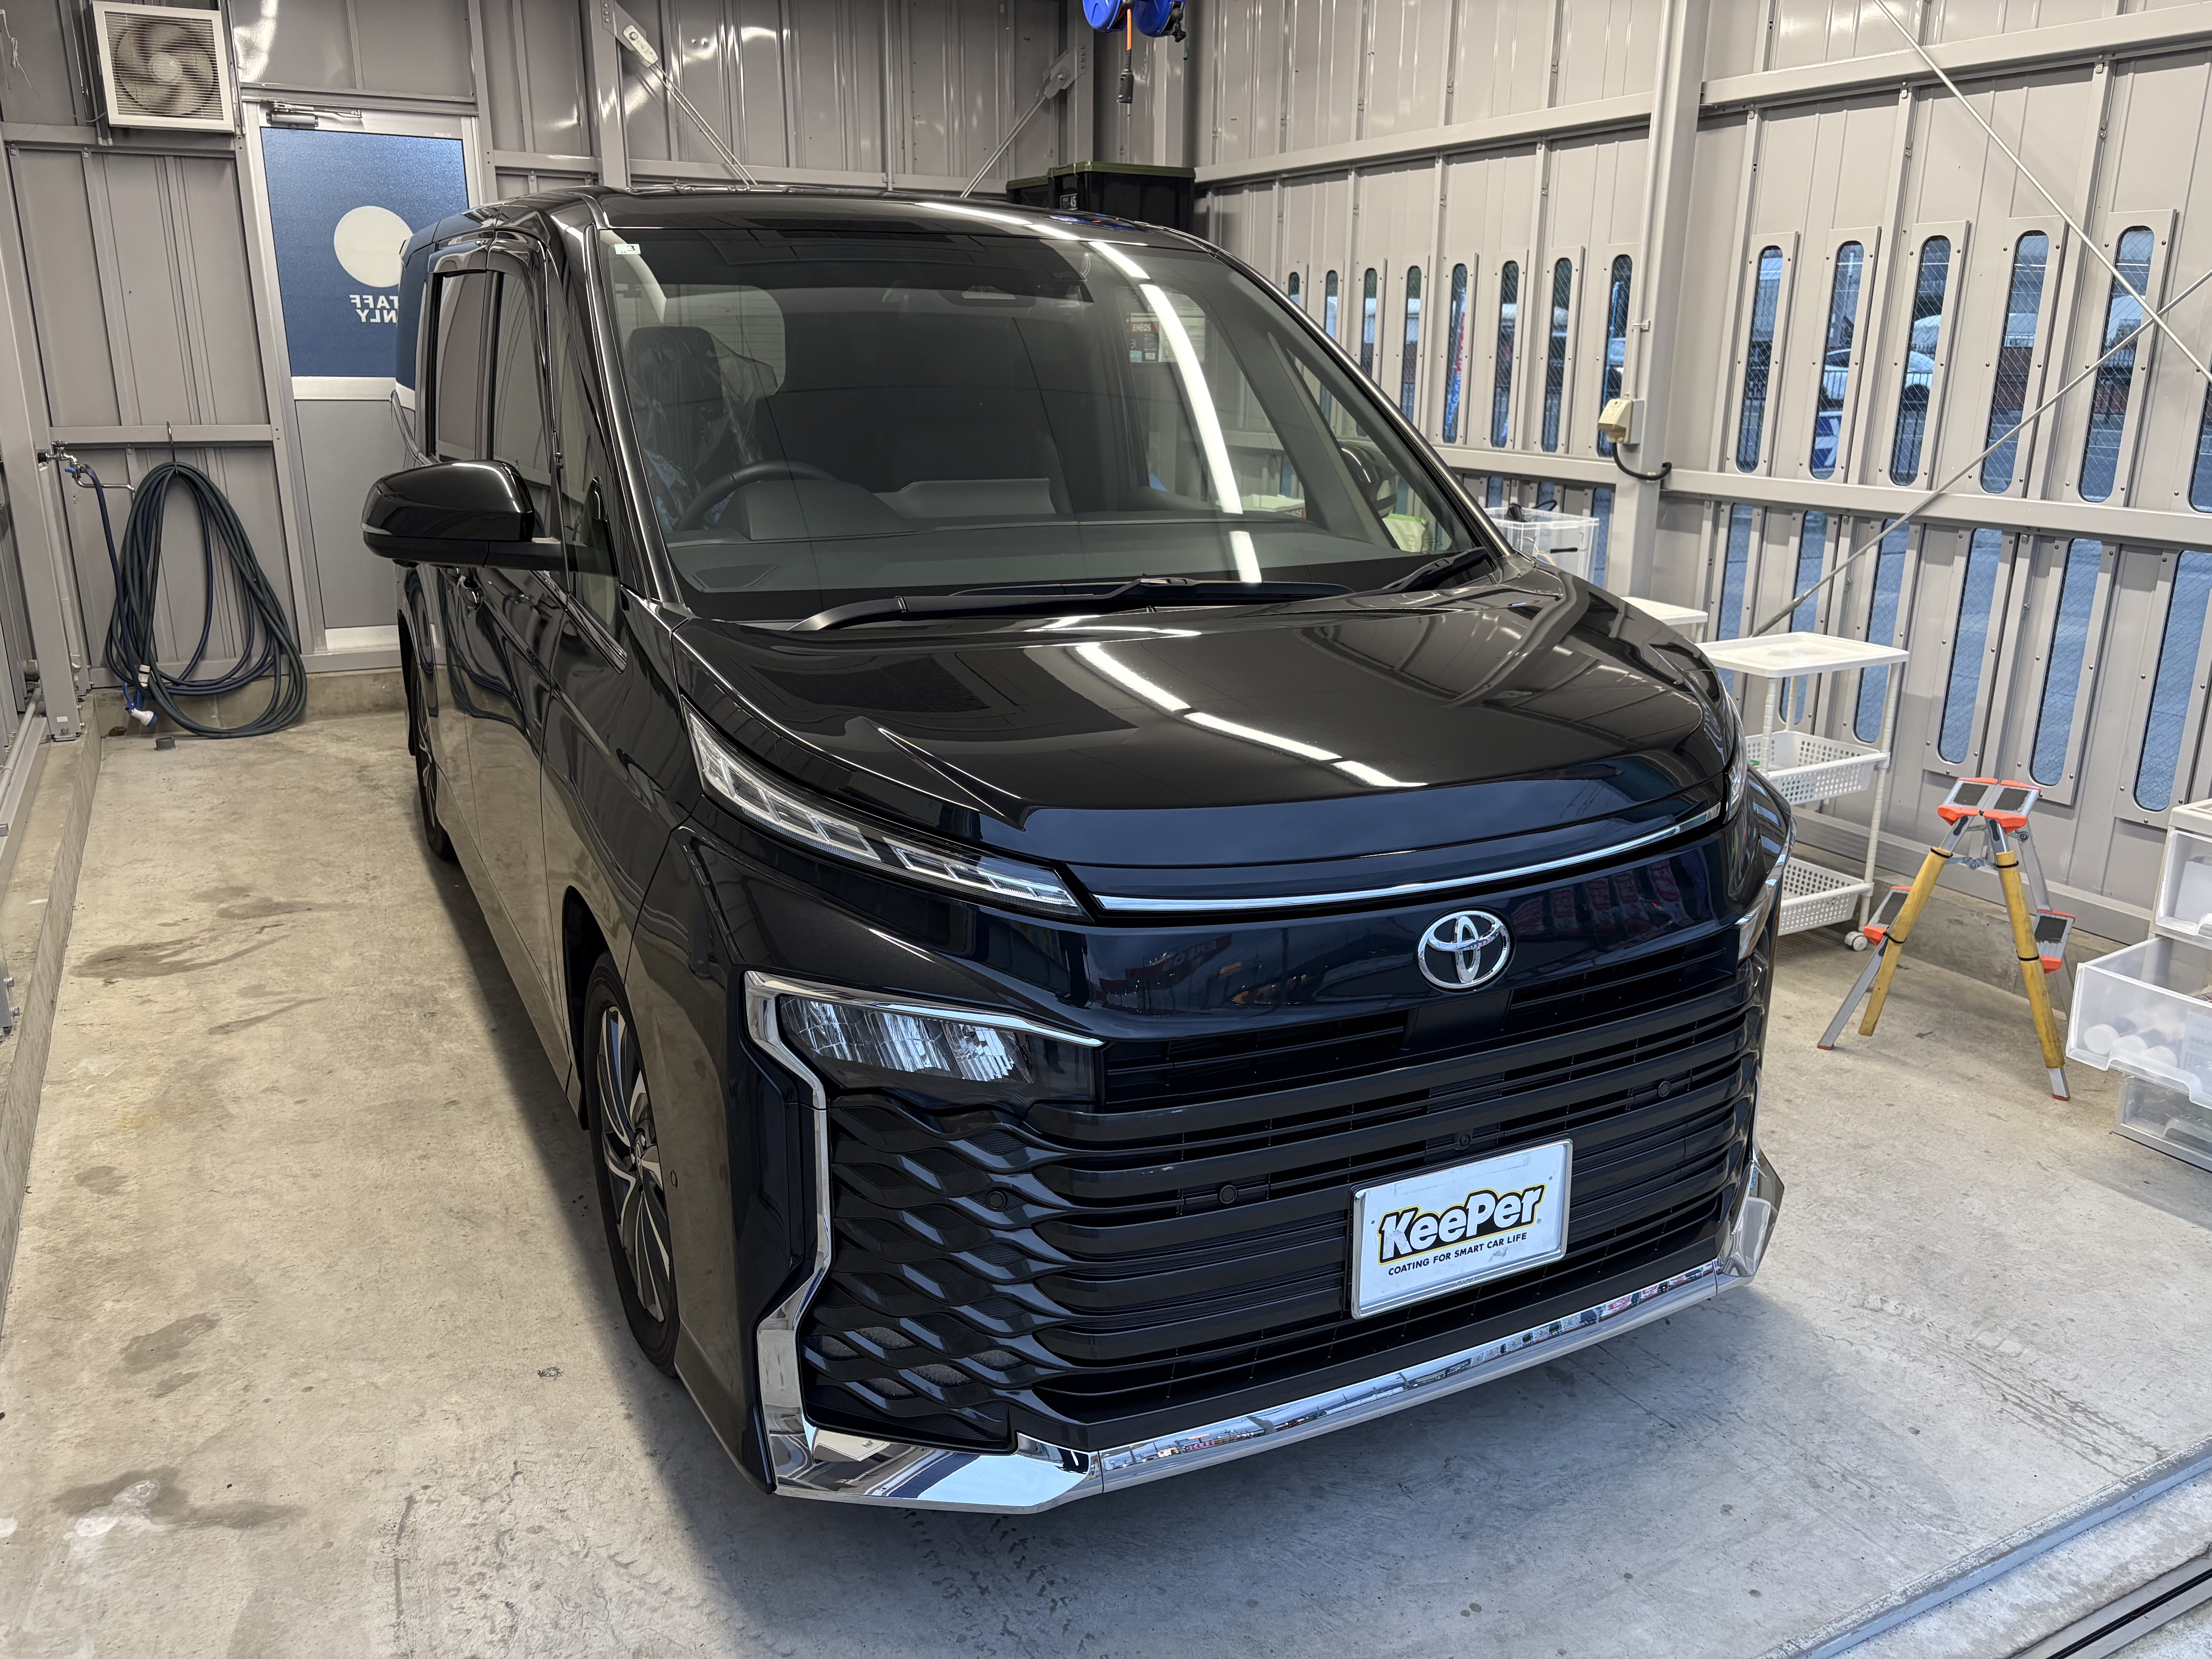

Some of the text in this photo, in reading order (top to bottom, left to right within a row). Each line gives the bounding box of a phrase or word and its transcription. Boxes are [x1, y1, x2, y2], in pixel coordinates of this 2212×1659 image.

[1380, 1186, 1543, 1261] KeePer
[1388, 1232, 1527, 1276] COATING FOR SMART CAR LIFE
